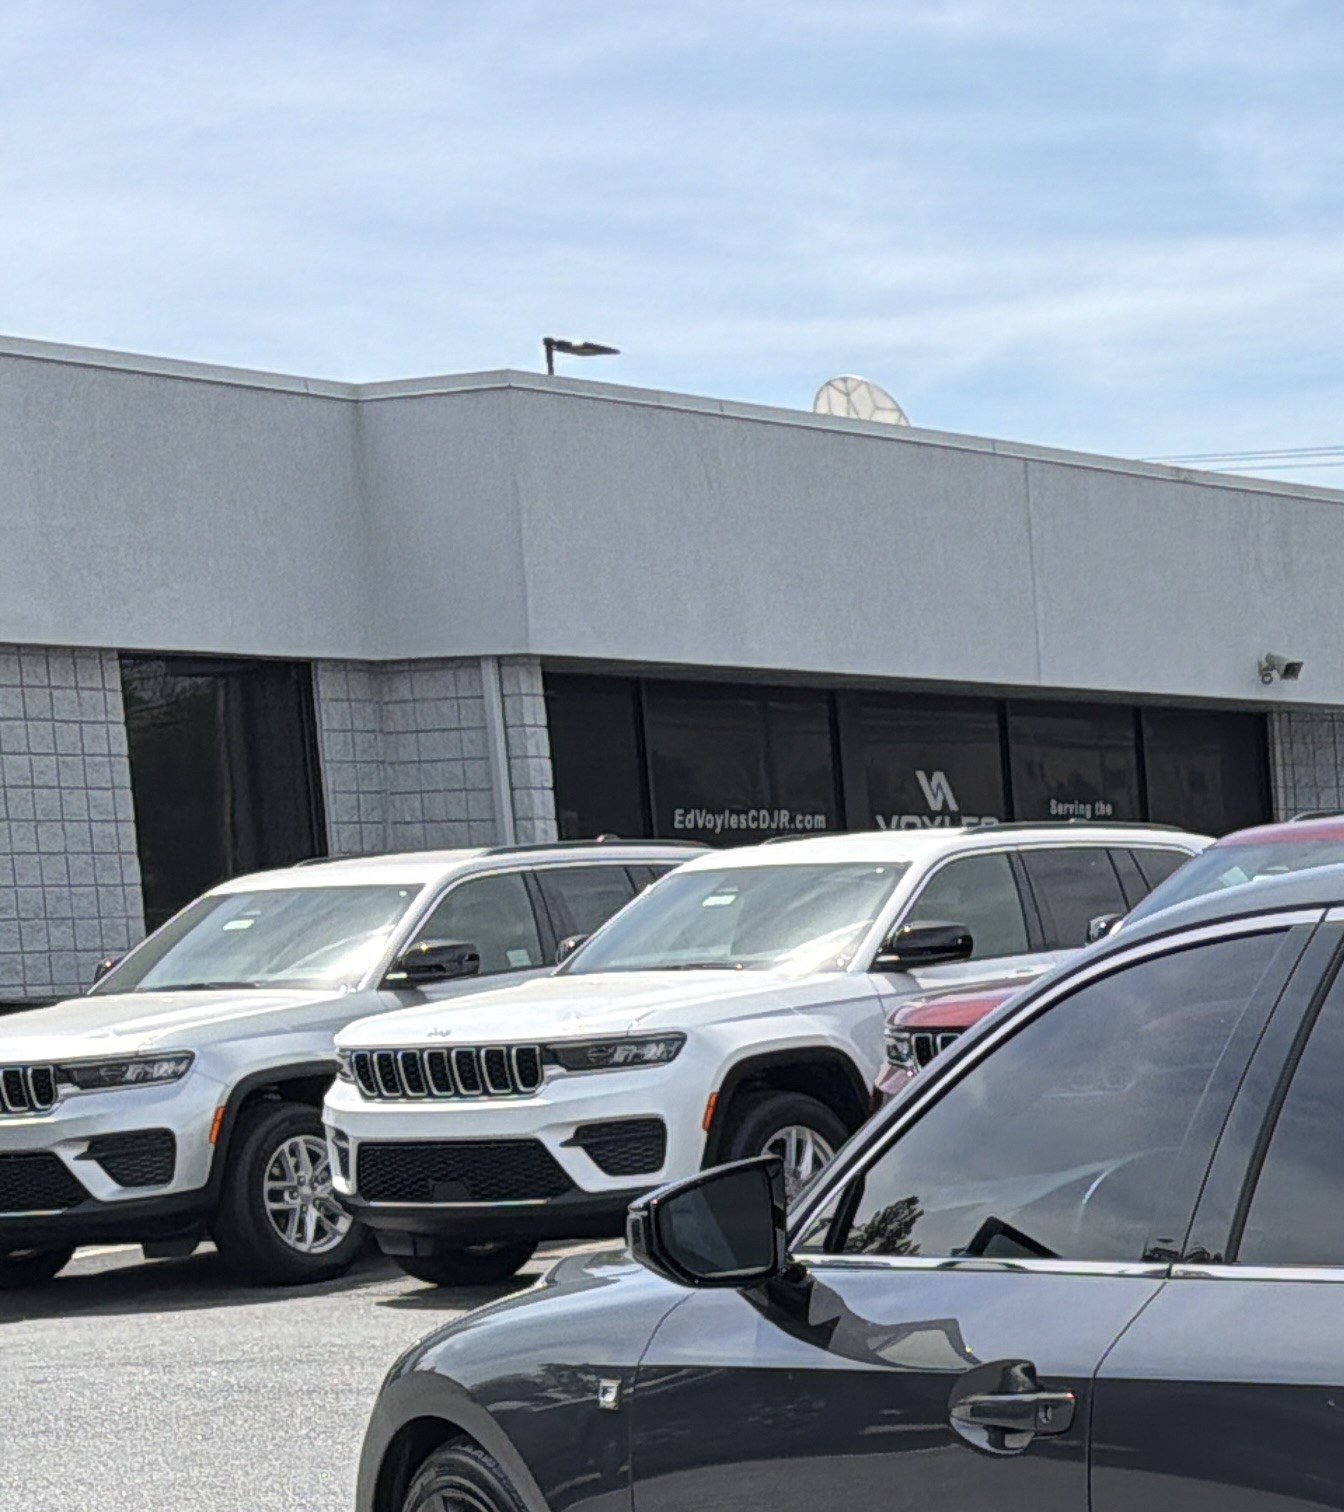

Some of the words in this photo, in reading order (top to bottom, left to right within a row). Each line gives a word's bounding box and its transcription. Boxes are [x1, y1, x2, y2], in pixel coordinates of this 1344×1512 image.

[1050, 799, 1091, 819] Serving
[1095, 800, 1113, 817] the
[673, 808, 827, 834] EdVoylesCDJR.com
